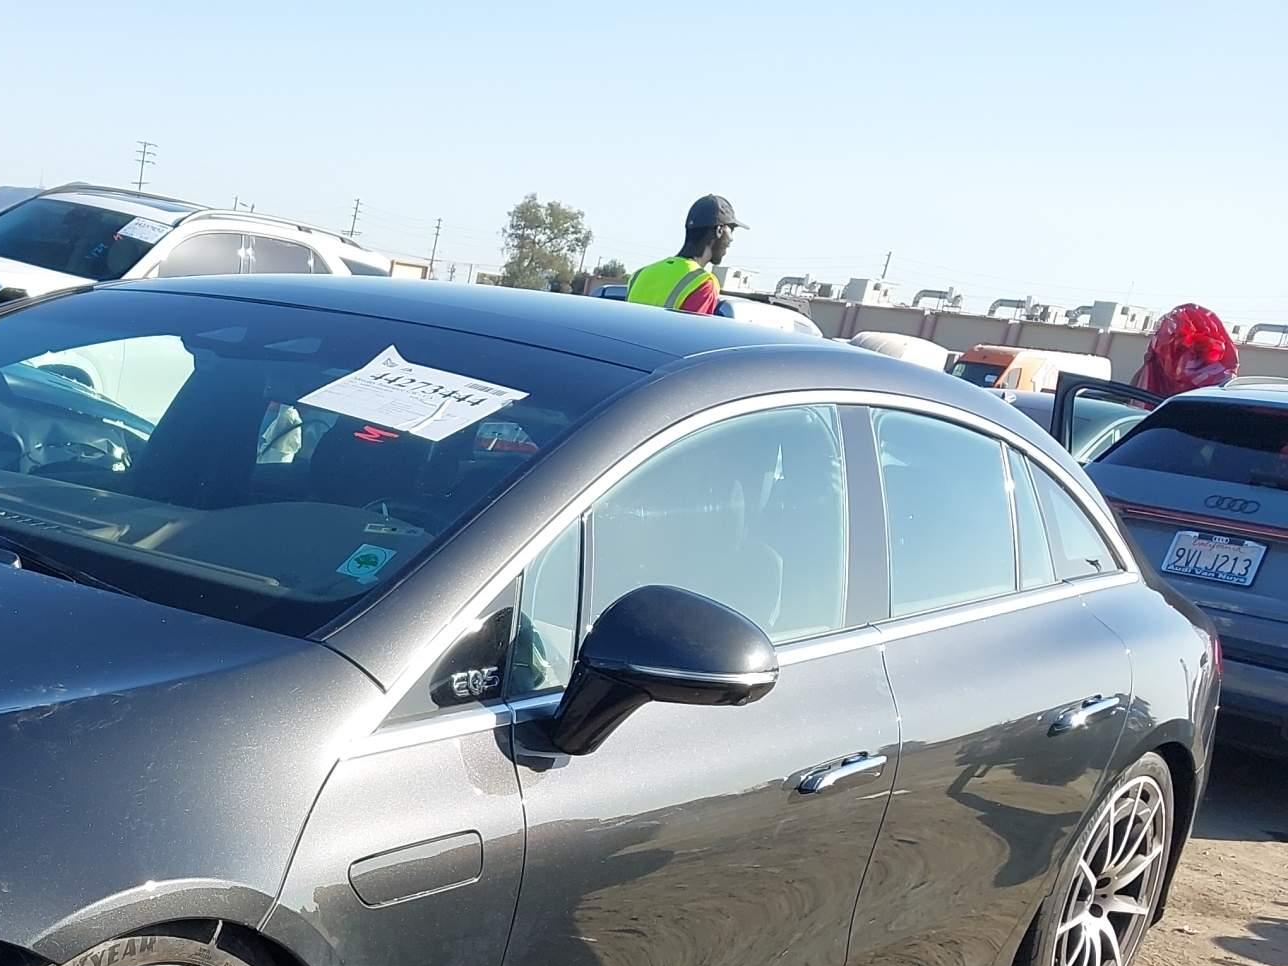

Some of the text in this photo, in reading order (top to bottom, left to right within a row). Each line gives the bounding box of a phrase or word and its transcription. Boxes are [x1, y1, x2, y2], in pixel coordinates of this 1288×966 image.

[369, 372, 489, 407] 44273444
[1167, 564, 1191, 574] Audi
[1170, 547, 1253, 576] 9VLJ213
